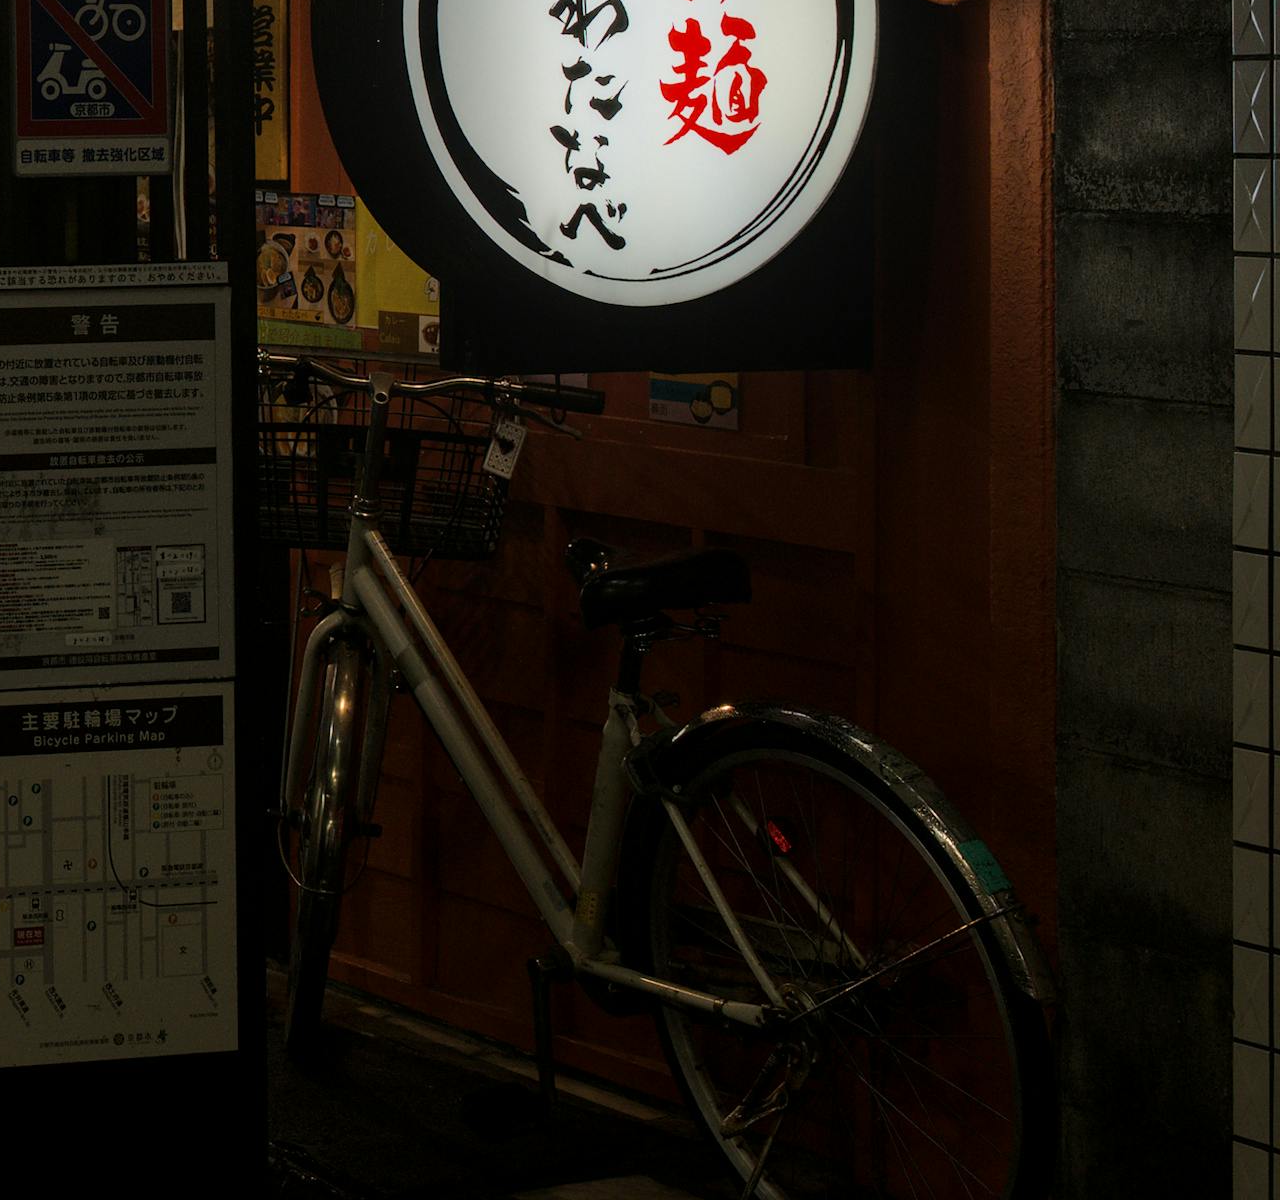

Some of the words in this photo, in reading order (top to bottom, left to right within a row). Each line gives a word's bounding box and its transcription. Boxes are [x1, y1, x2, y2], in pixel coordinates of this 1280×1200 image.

[73, 103, 111, 117] 京都市
[20, 148, 75, 164] 自転車等
[82, 147, 165, 162] 撤去強化区域
[71, 313, 120, 336] 警告
[21, 705, 178, 732] 主要駐輪場マップ
[33, 734, 81, 747] Bicycle
[85, 732, 134, 745] Parking
[139, 731, 166, 743] Map
